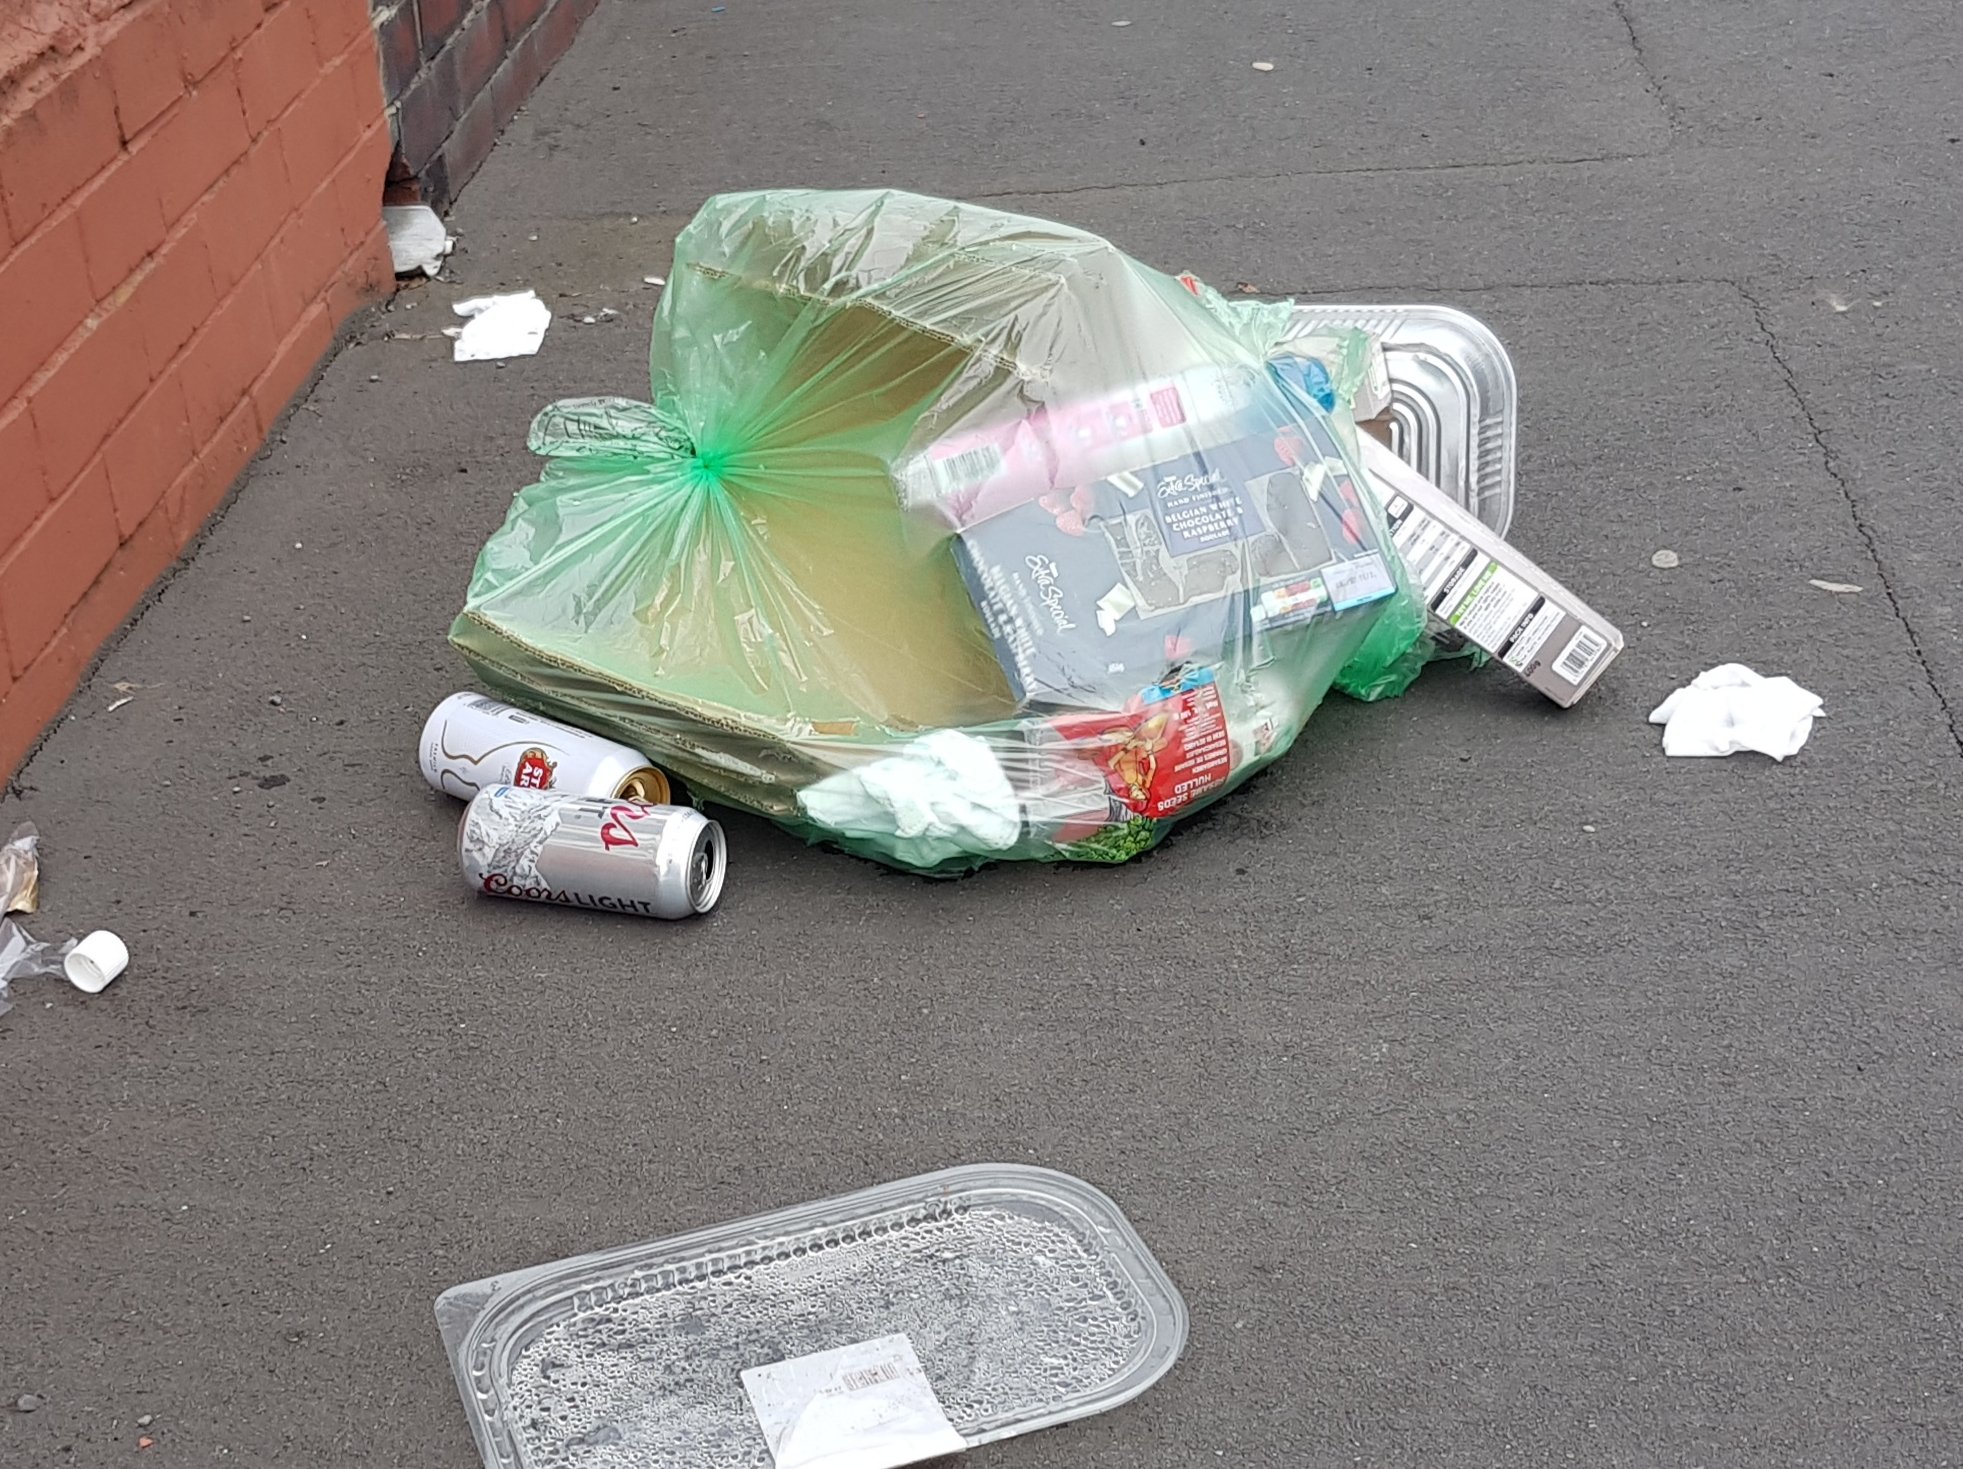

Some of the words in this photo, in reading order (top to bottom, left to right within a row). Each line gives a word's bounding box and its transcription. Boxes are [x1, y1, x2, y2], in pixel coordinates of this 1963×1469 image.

[1165, 506, 1207, 524] BELGIAN
[1209, 497, 1243, 512] WHITE
[1173, 509, 1234, 532] CHOCOLATE
[1183, 517, 1240, 539] RASPBERRY
[1445, 568, 1465, 594] STORAGE
[1510, 627, 1523, 643] PACK
[1521, 612, 1534, 628] INFO
[1174, 773, 1211, 794] HULLED
[1157, 793, 1189, 810] SEEDS
[573, 892, 651, 914] LIGHT
